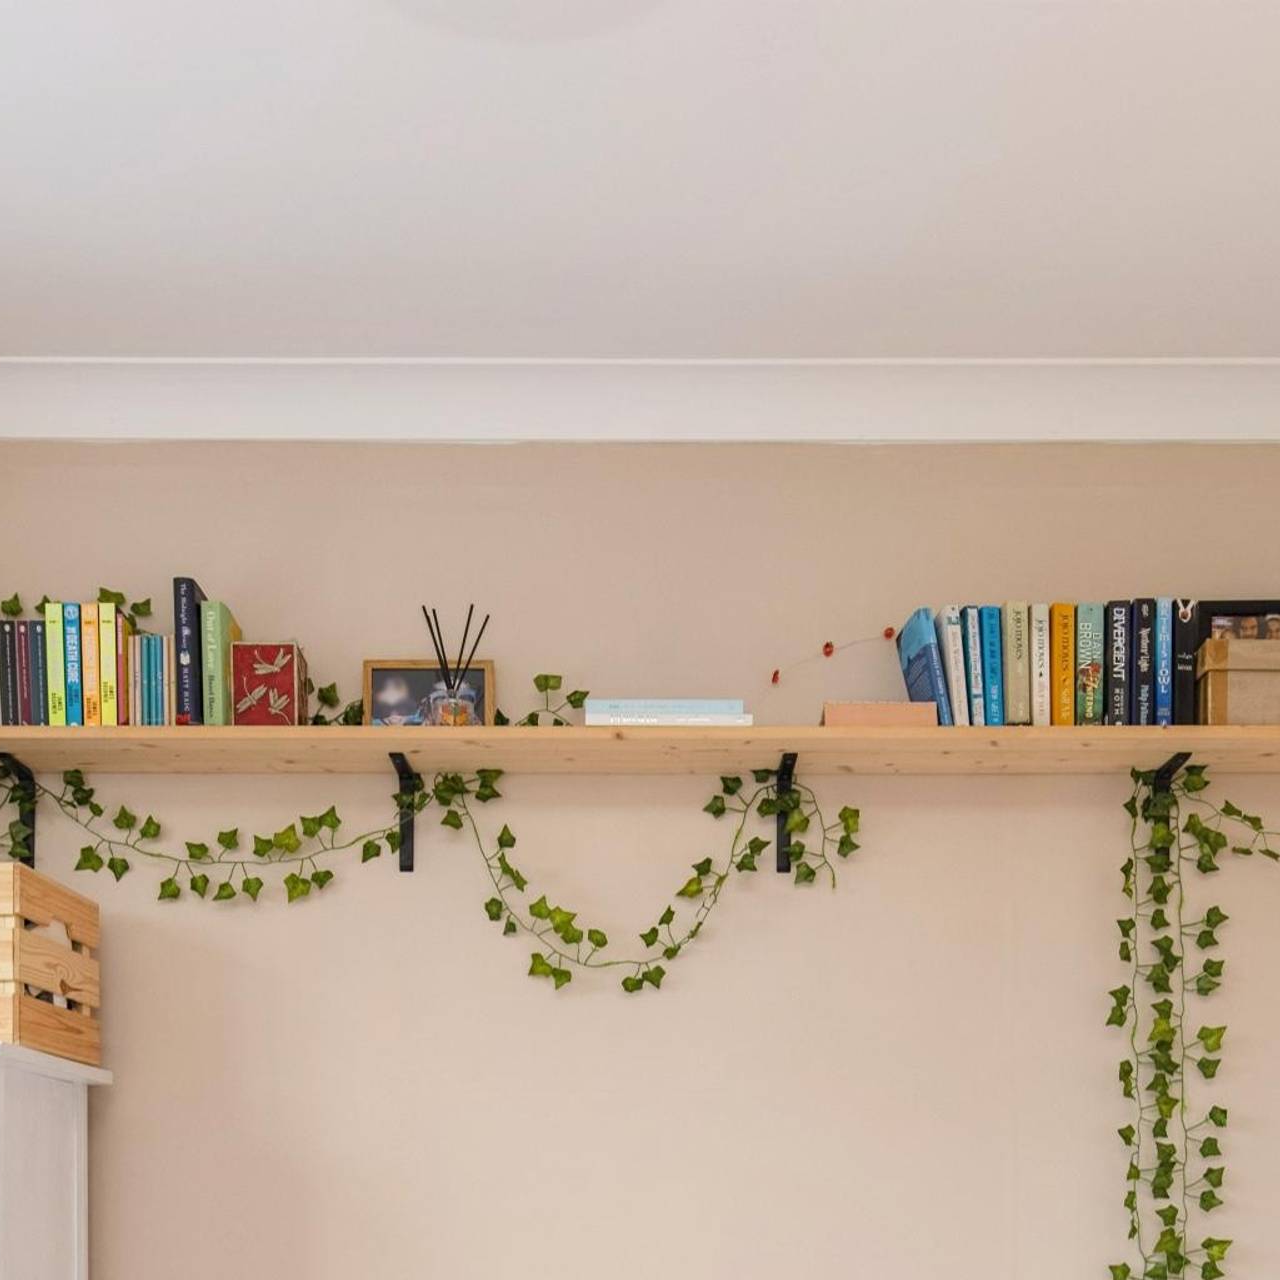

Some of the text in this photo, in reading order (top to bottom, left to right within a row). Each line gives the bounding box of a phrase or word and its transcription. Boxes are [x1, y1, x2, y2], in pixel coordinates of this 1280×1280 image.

[1079, 622, 1092, 669] BROWN
[1092, 632, 1102, 659] DAN
[1112, 607, 1126, 681] DIVERGENT
